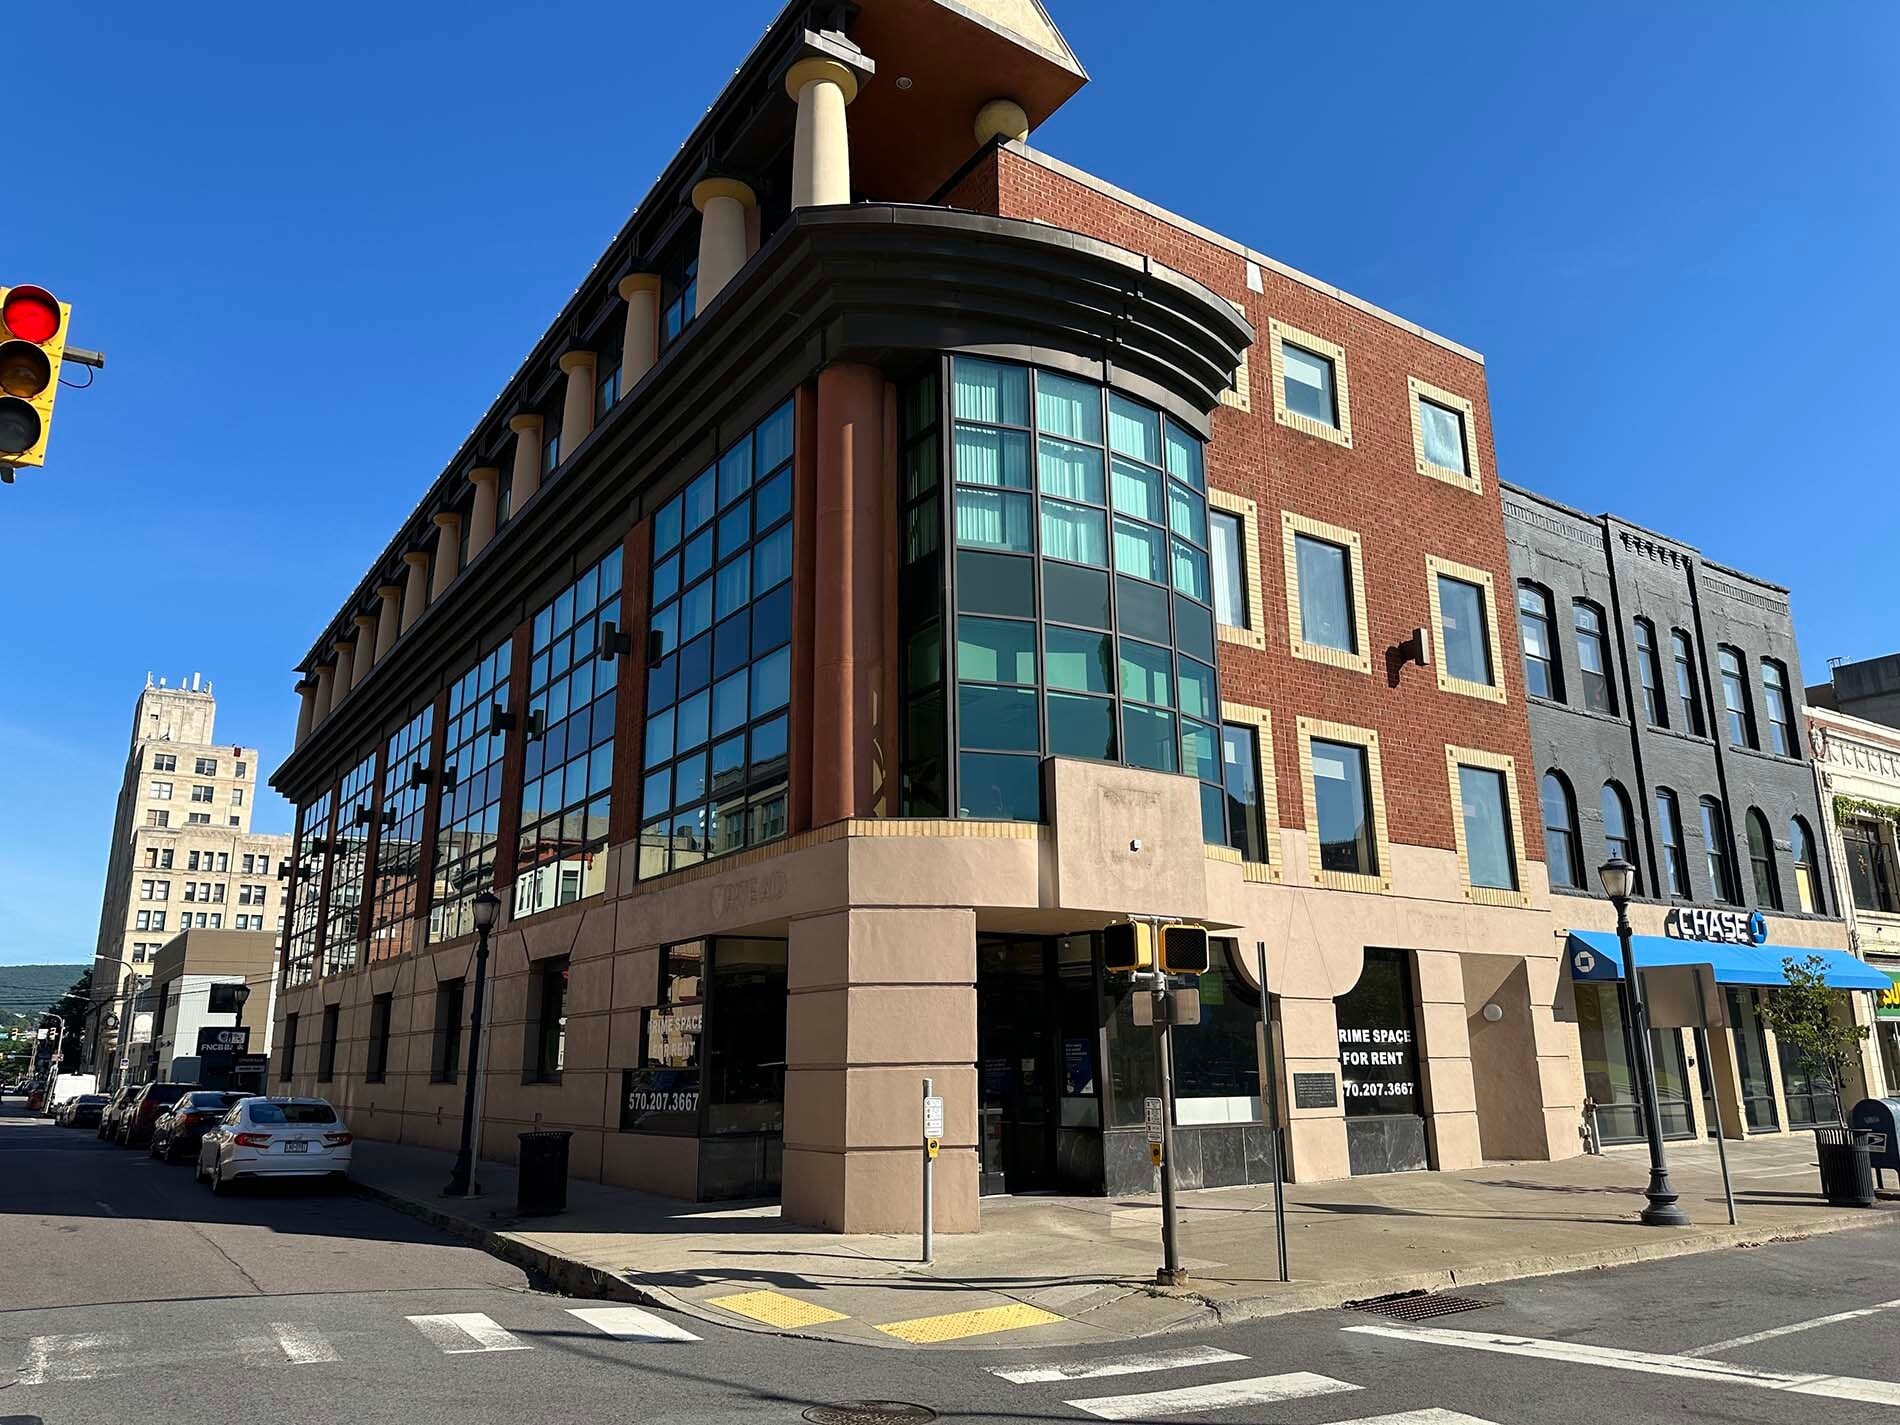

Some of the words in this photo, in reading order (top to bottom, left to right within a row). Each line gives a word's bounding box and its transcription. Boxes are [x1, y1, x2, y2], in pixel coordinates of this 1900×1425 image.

[1678, 907, 1750, 940] CHASE
[1882, 982, 1900, 1005] SU
[675, 1014, 703, 1032] SPACE
[1338, 1029, 1371, 1043] RIME
[1372, 1029, 1411, 1043] SPACE
[671, 1041, 696, 1058] RENT
[1342, 1051, 1369, 1065] FOR
[1370, 1051, 1404, 1065] RENT
[1343, 1082, 1414, 1097] 70.207.3667
[628, 1092, 699, 1111] 570.207.3667
